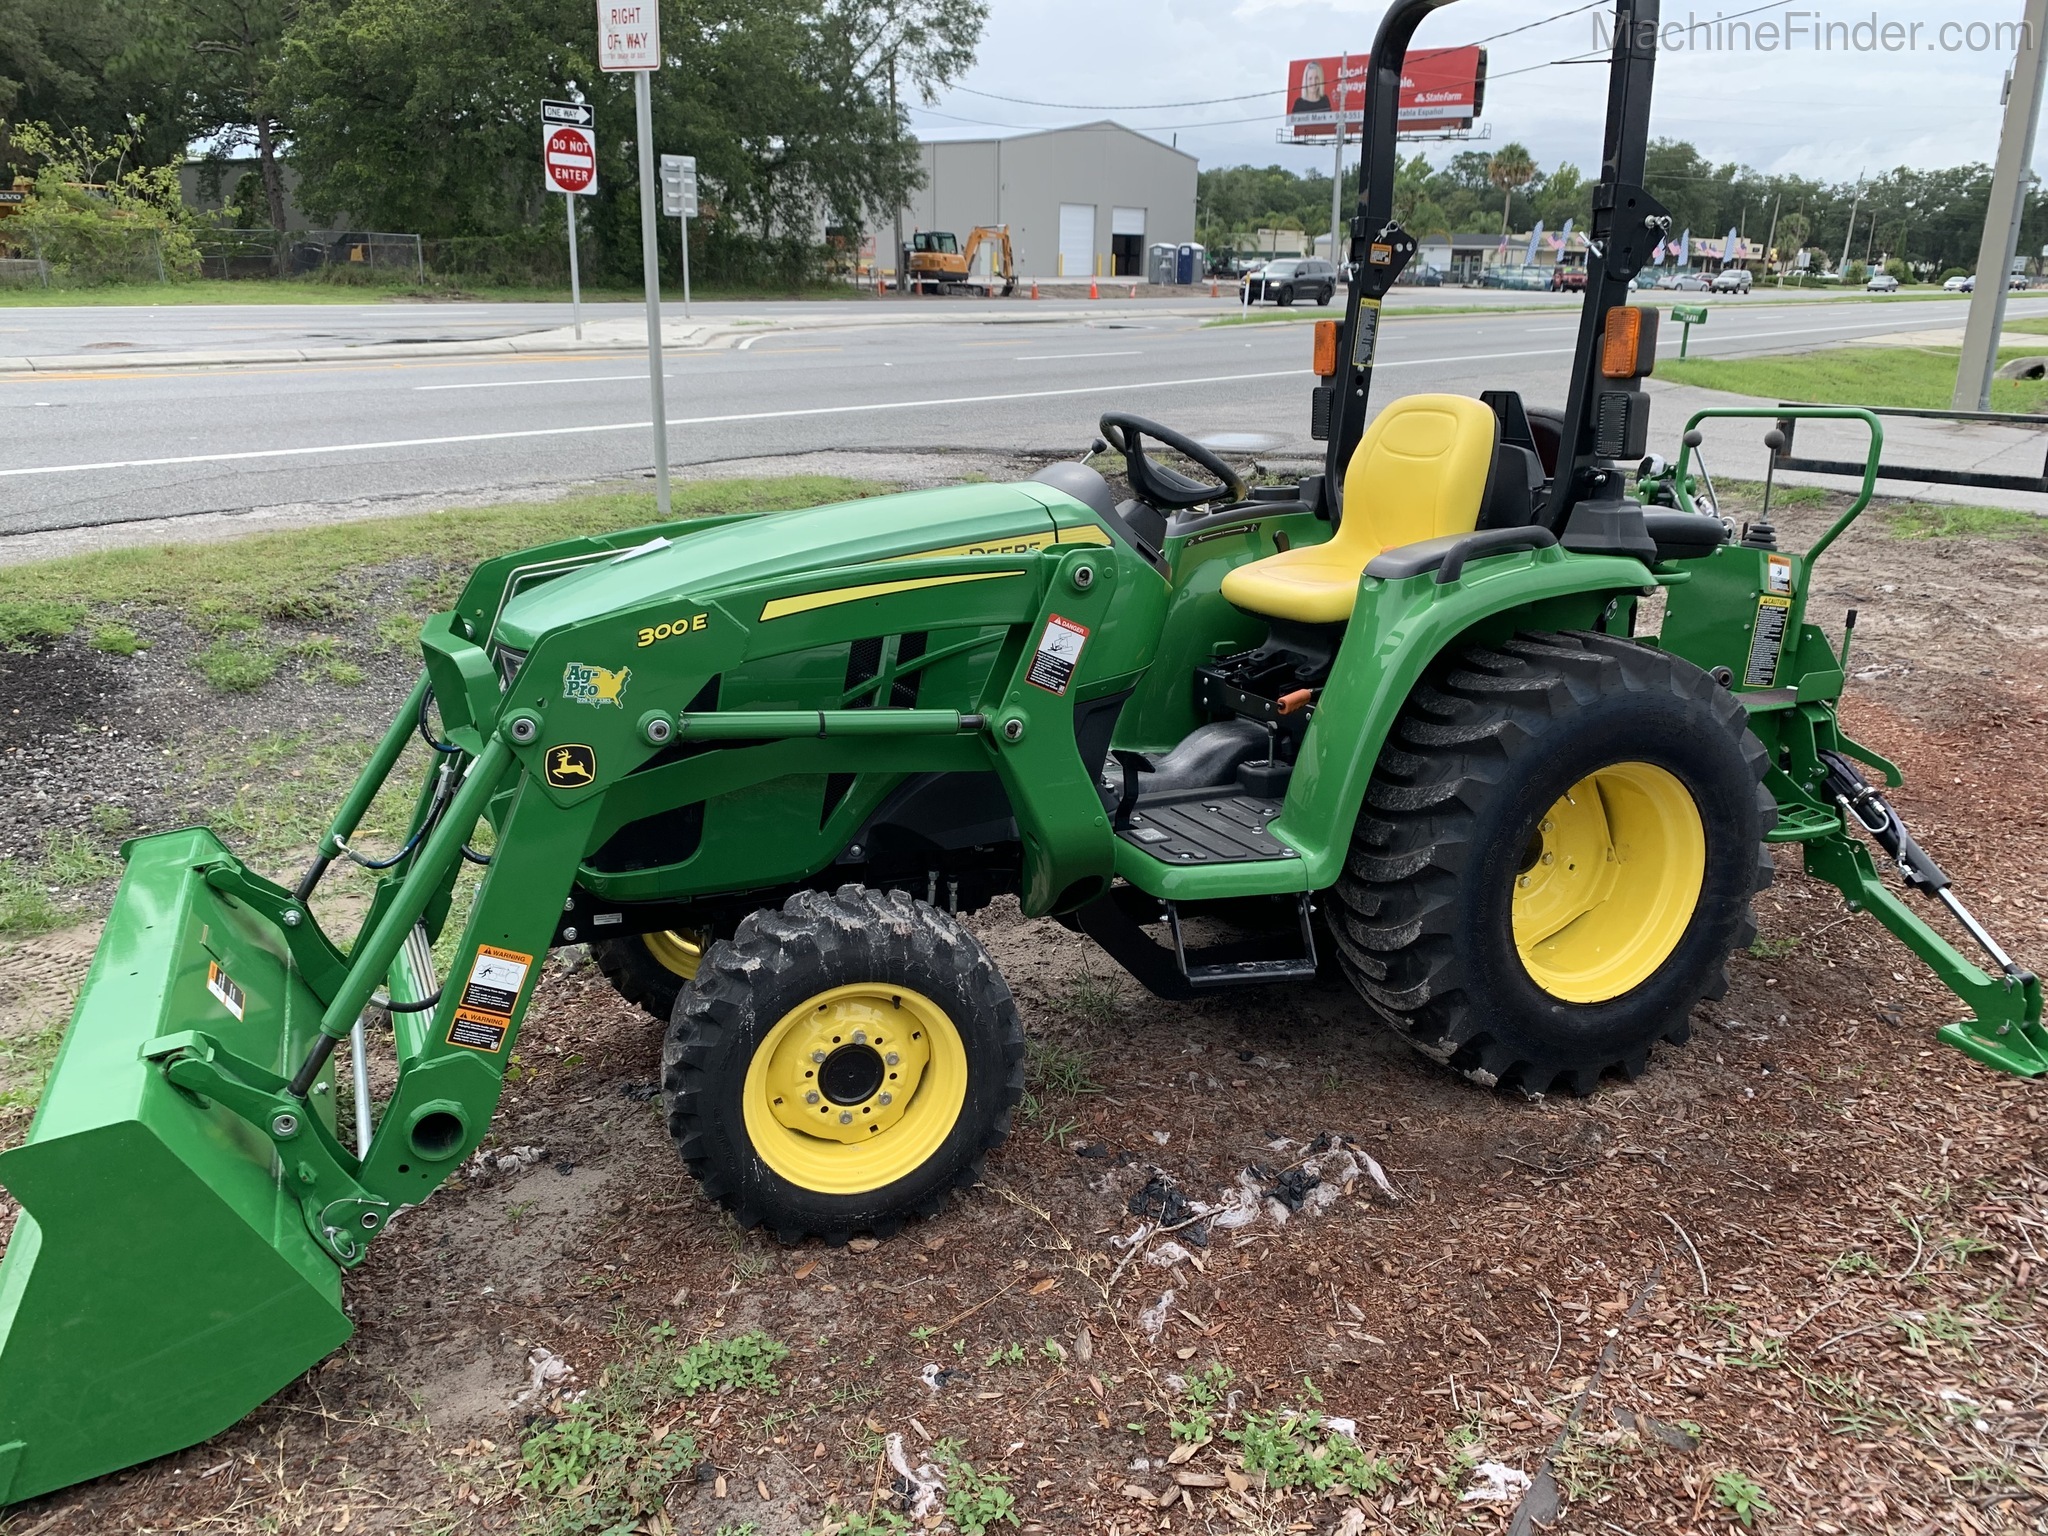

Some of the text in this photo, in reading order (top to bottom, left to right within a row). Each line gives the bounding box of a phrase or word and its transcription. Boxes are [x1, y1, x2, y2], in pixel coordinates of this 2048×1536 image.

[612, 8, 640, 24] RIGHT
[608, 32, 648, 50] OF WAY
[547, 108, 578, 118] ONE WAY
[552, 138, 589, 153] DO NOT
[556, 168, 588, 182] ENTER
[1062, 620, 1084, 633] DANGER
[566, 666, 598, 684] Ag-
[566, 681, 598, 696] Pro
[493, 950, 526, 962] WARNING
[470, 1014, 504, 1026] WARNING
